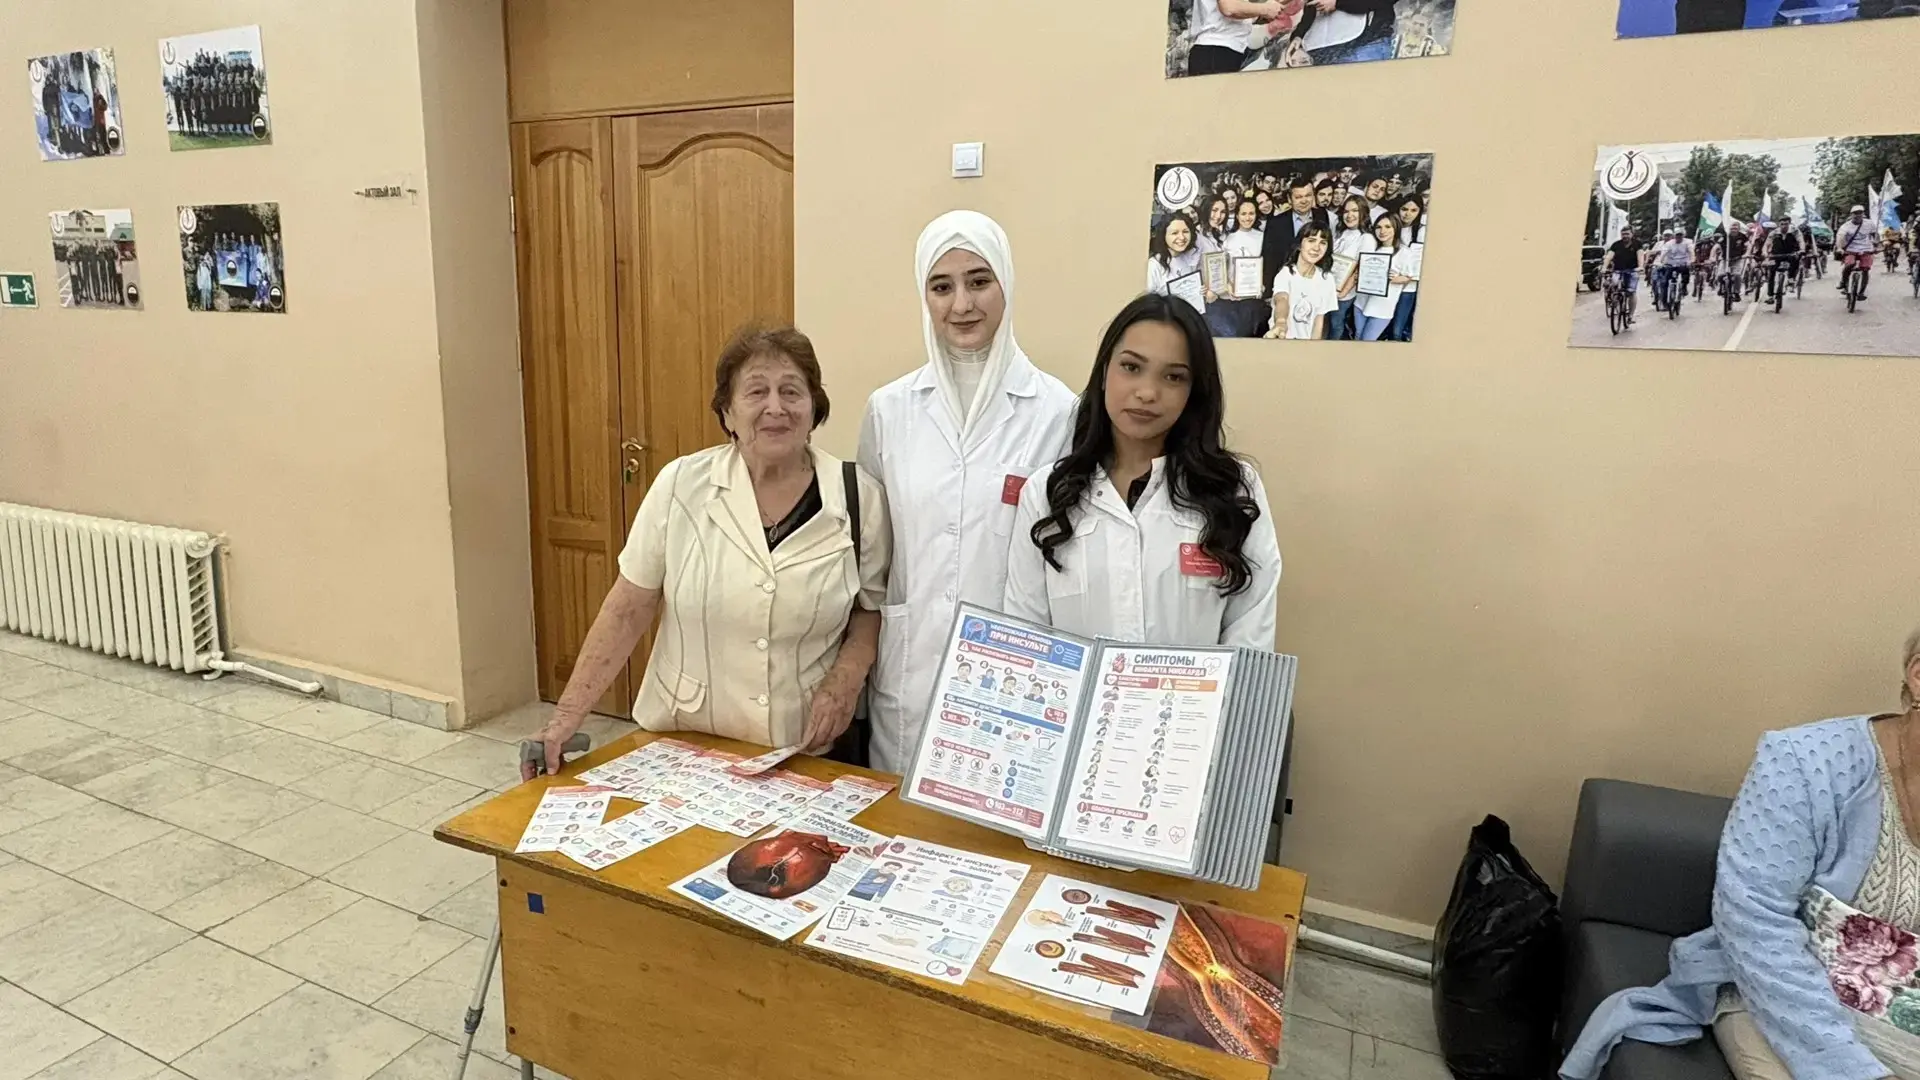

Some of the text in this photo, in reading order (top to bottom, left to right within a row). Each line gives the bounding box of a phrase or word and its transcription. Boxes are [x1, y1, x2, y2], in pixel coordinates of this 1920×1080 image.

[364, 185, 402, 198] АКТОВЫЙ ЗАЛ
[989, 630, 1008, 641] ПРИ
[1008, 636, 1050, 653] ИНСУЛЬТЕ
[1134, 654, 1196, 666] СИМПТОМЫ
[802, 817, 869, 844] АТЕРОСКЛЕРОЗА
[809, 812, 871, 839] ПРОФИЛАКТИКА
[916, 846, 954, 860] Инфаркт
[938, 858, 959, 866] часы
[968, 865, 1003, 877] золотые
